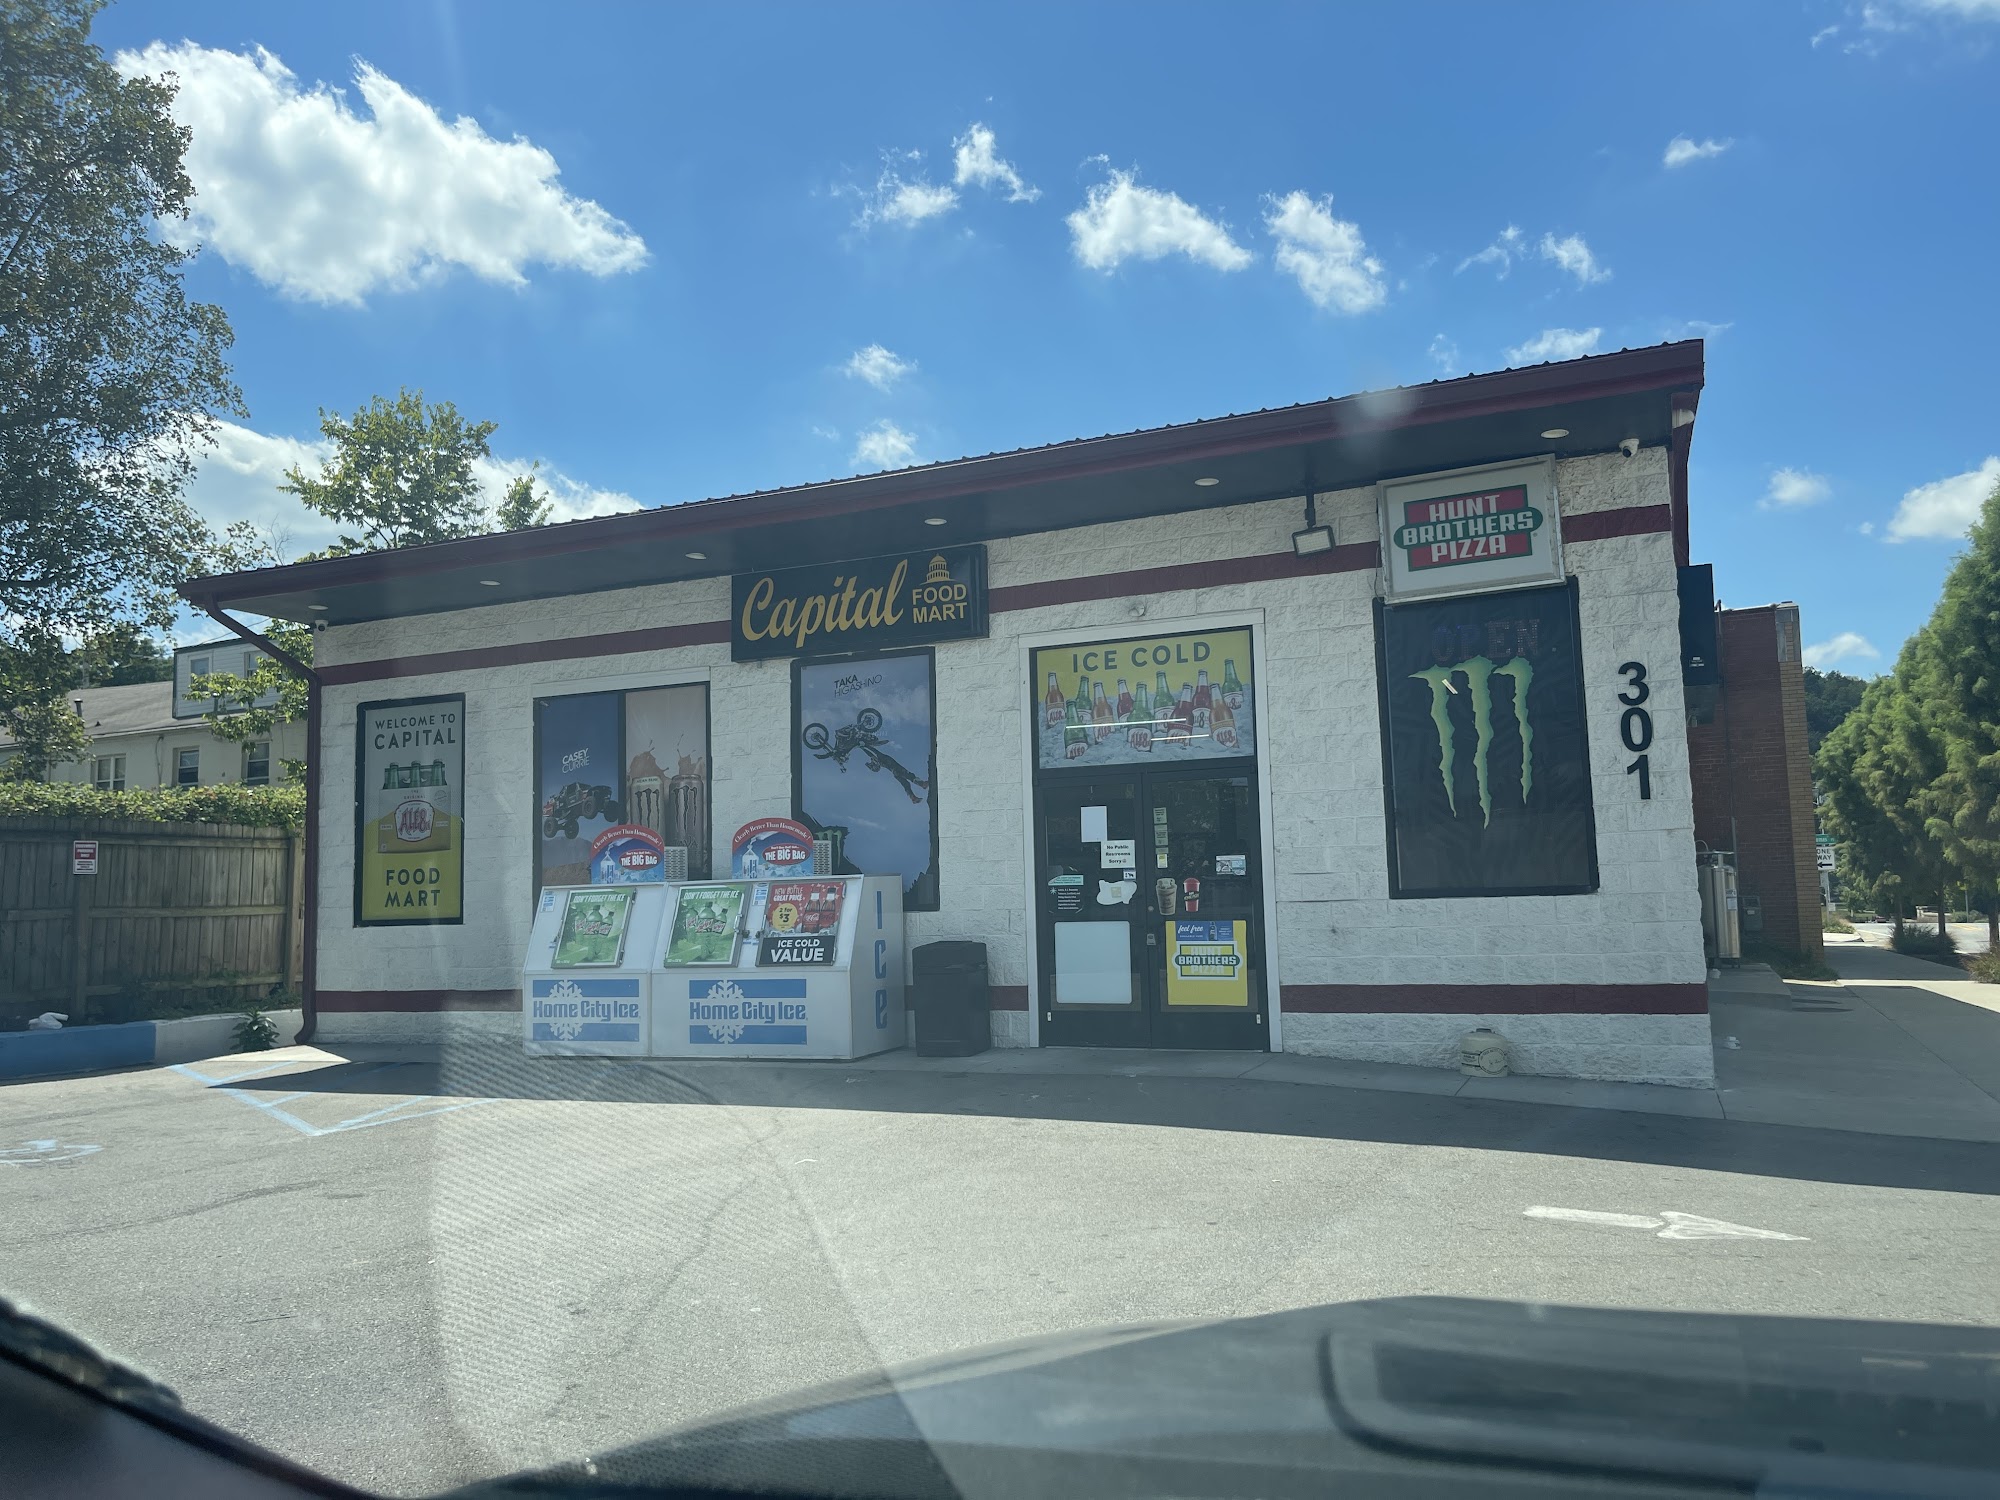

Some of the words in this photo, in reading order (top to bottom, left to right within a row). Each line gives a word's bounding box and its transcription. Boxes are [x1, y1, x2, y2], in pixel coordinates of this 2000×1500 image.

[1428, 494, 1500, 522] HUNT
[1402, 511, 1533, 546] BROTHERS
[1431, 534, 1507, 563] PIZZA
[741, 559, 908, 648] Capital
[912, 583, 967, 605] FOOD
[912, 602, 968, 624] MART
[1432, 619, 1540, 661] OPEN
[1072, 650, 1117, 673] ICE
[1131, 641, 1211, 668] COLD
[834, 674, 858, 689] TAKA
[834, 674, 883, 699] HIGASHINO
[375, 715, 436, 730] WELCOME
[441, 713, 456, 724] TO
[1617, 661, 1653, 800] 301
[374, 728, 456, 750] CAPITAL
[562, 747, 589, 765] CASEY
[562, 756, 590, 774] CURRIE
[593, 835, 608, 849] Clearly
[607, 830, 622, 839] Better
[734, 829, 750, 843] Clearly
[750, 822, 766, 832] Better
[621, 857, 631, 866] THE
[632, 855, 644, 866] BIG
[645, 855, 658, 865] BAG
[765, 851, 776, 861] THE
[777, 849, 791, 861] BIG
[792, 850, 806, 860] BAG
[386, 867, 440, 887] FOOD
[384, 889, 441, 908] MART
[573, 895, 589, 903] DON'T
[607, 894, 617, 902] THE
[617, 893, 626, 902] ICE
[684, 892, 700, 900] DON'T
[700, 891, 720, 899] FORGET
[720, 890, 732, 899] THE
[731, 890, 740, 898] ICE
[786, 886, 803, 895] BOTTLE
[779, 913, 790, 923] $3
[1177, 924, 1190, 934] feel
[1189, 924, 1204, 934] free
[777, 939, 793, 948] ICE
[794, 939, 820, 948] COLD
[1190, 946, 1222, 956] HUNT
[770, 947, 825, 963] VALUE
[1178, 955, 1237, 965] BROTHERS
[1190, 965, 1225, 974] PIZZA
[533, 1000, 578, 1018] Home
[580, 1000, 612, 1022] City
[613, 1000, 639, 1018] Ice
[689, 1001, 739, 1020] Home
[741, 1001, 776, 1024] City
[778, 1001, 806, 1020] Ice
